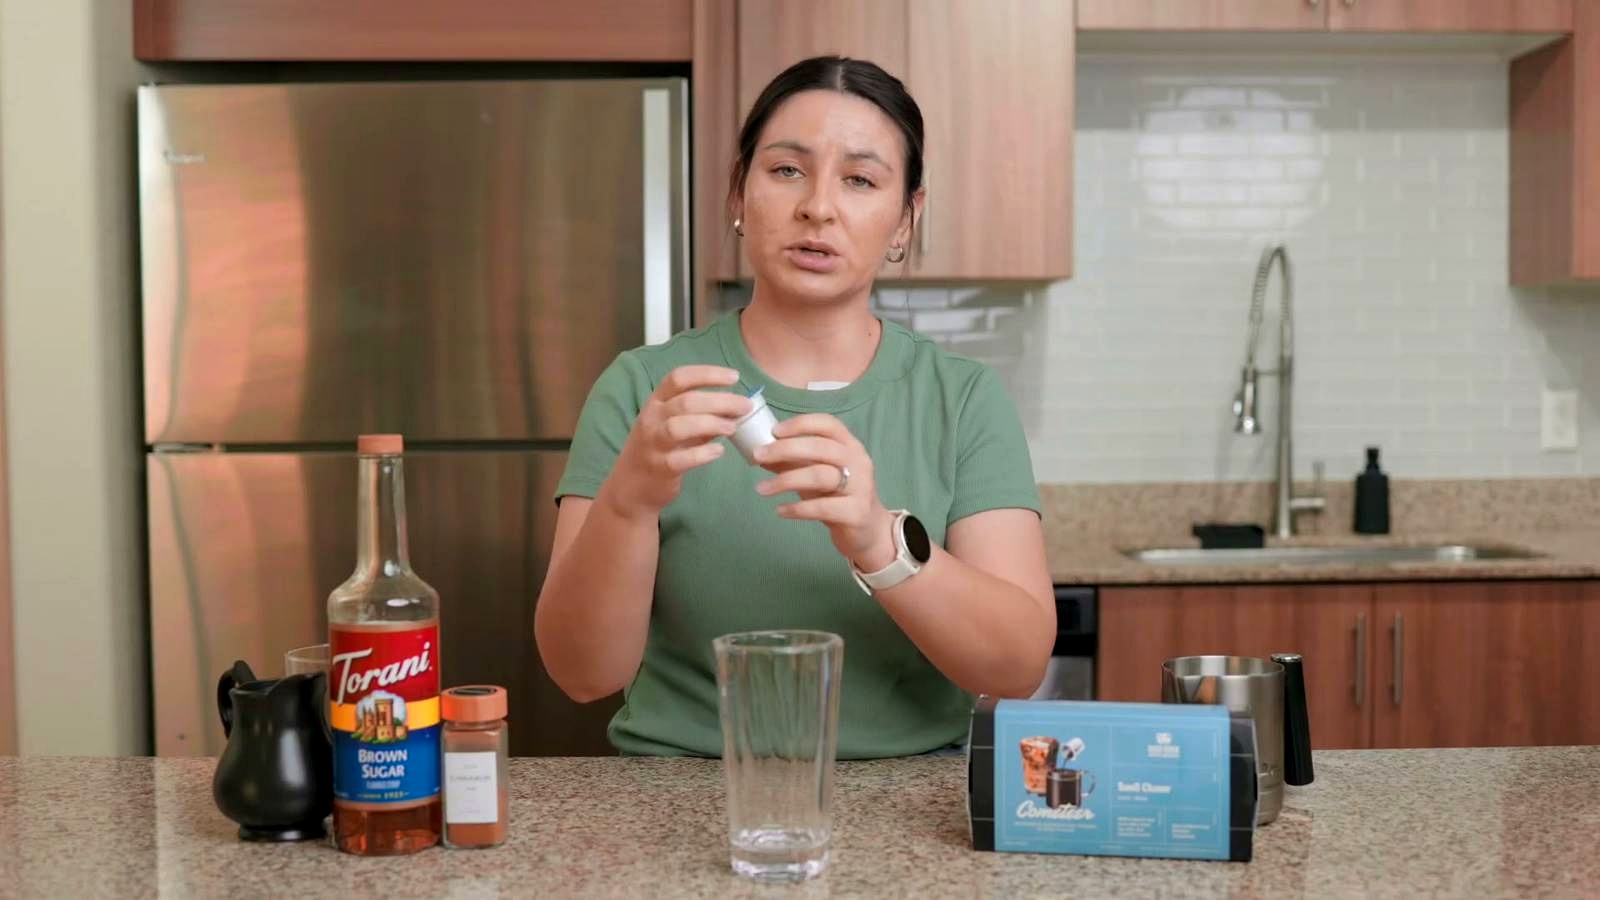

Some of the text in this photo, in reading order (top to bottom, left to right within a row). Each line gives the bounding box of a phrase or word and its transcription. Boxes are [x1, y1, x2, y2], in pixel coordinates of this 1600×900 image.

[332, 641, 431, 706] Torani
[358, 749, 408, 763] BROWN
[361, 764, 405, 778] SUGAR
